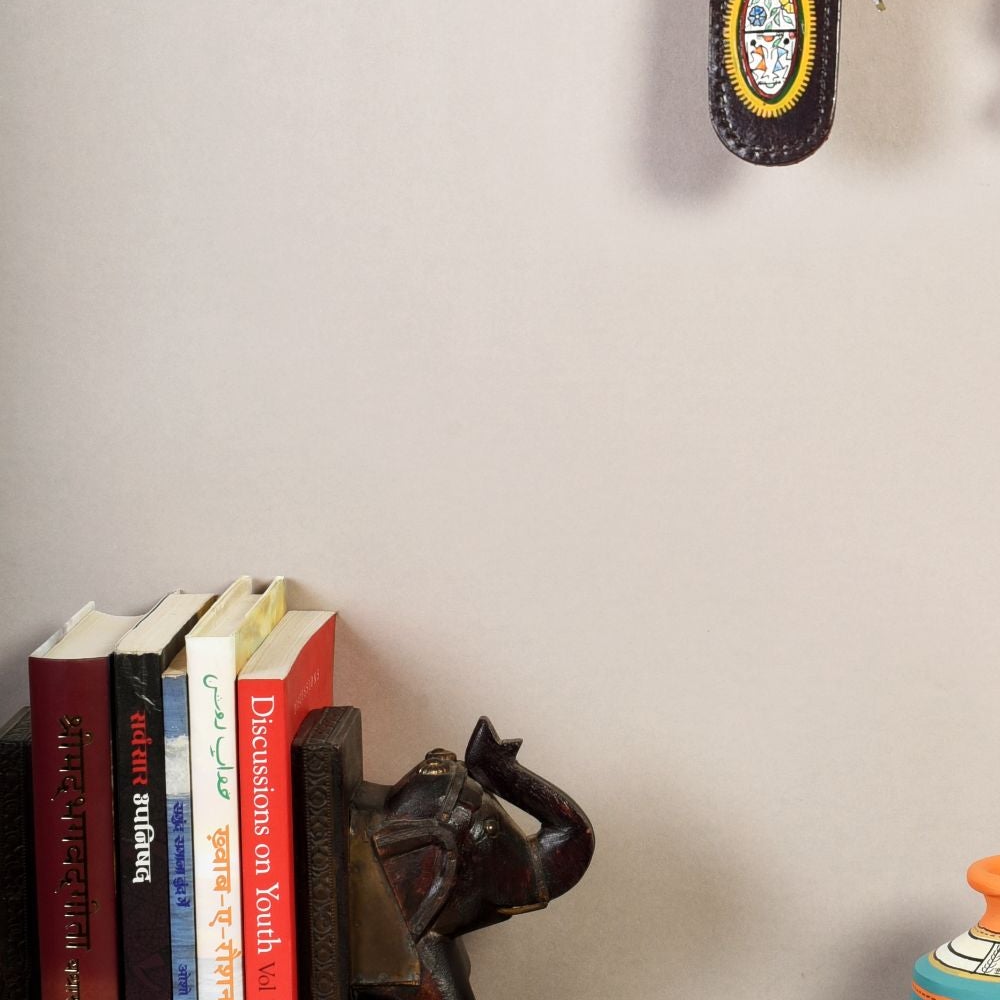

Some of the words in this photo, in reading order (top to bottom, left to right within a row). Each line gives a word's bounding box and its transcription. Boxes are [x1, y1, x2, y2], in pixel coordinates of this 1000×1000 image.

[251, 696, 275, 836] Discussions
[132, 793, 155, 883] उपनिषद
[254, 843, 271, 875] on
[256, 882, 282, 954] Youth
[178, 963, 192, 996] ओशो
[258, 961, 276, 991] Vol
